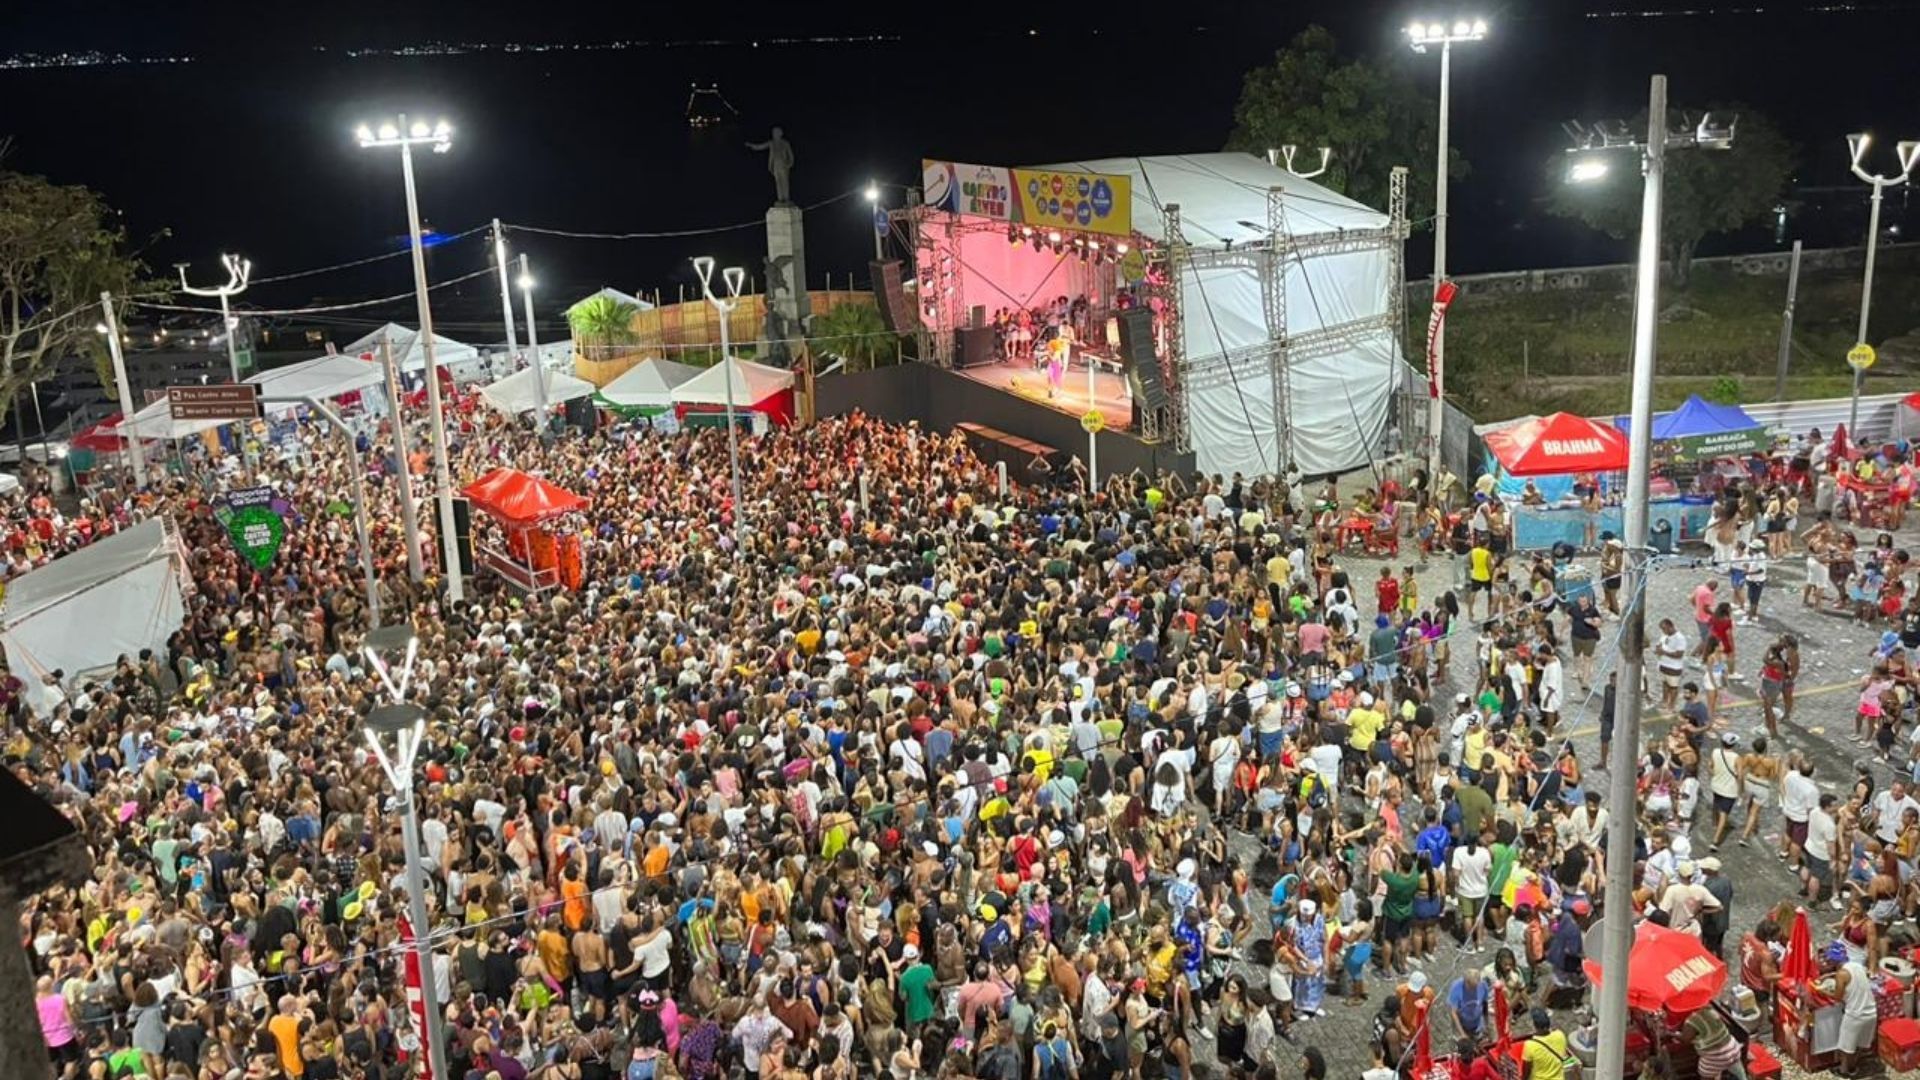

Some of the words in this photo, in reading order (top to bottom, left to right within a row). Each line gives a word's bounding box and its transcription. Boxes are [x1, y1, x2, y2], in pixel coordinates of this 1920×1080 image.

[1705, 434, 1747, 445] BARRACA
[1542, 438, 1606, 456] BRAHMA
[1697, 446, 1722, 454] POINT
[1724, 443, 1736, 452] DO
[1664, 955, 1717, 992] BRAHMA
